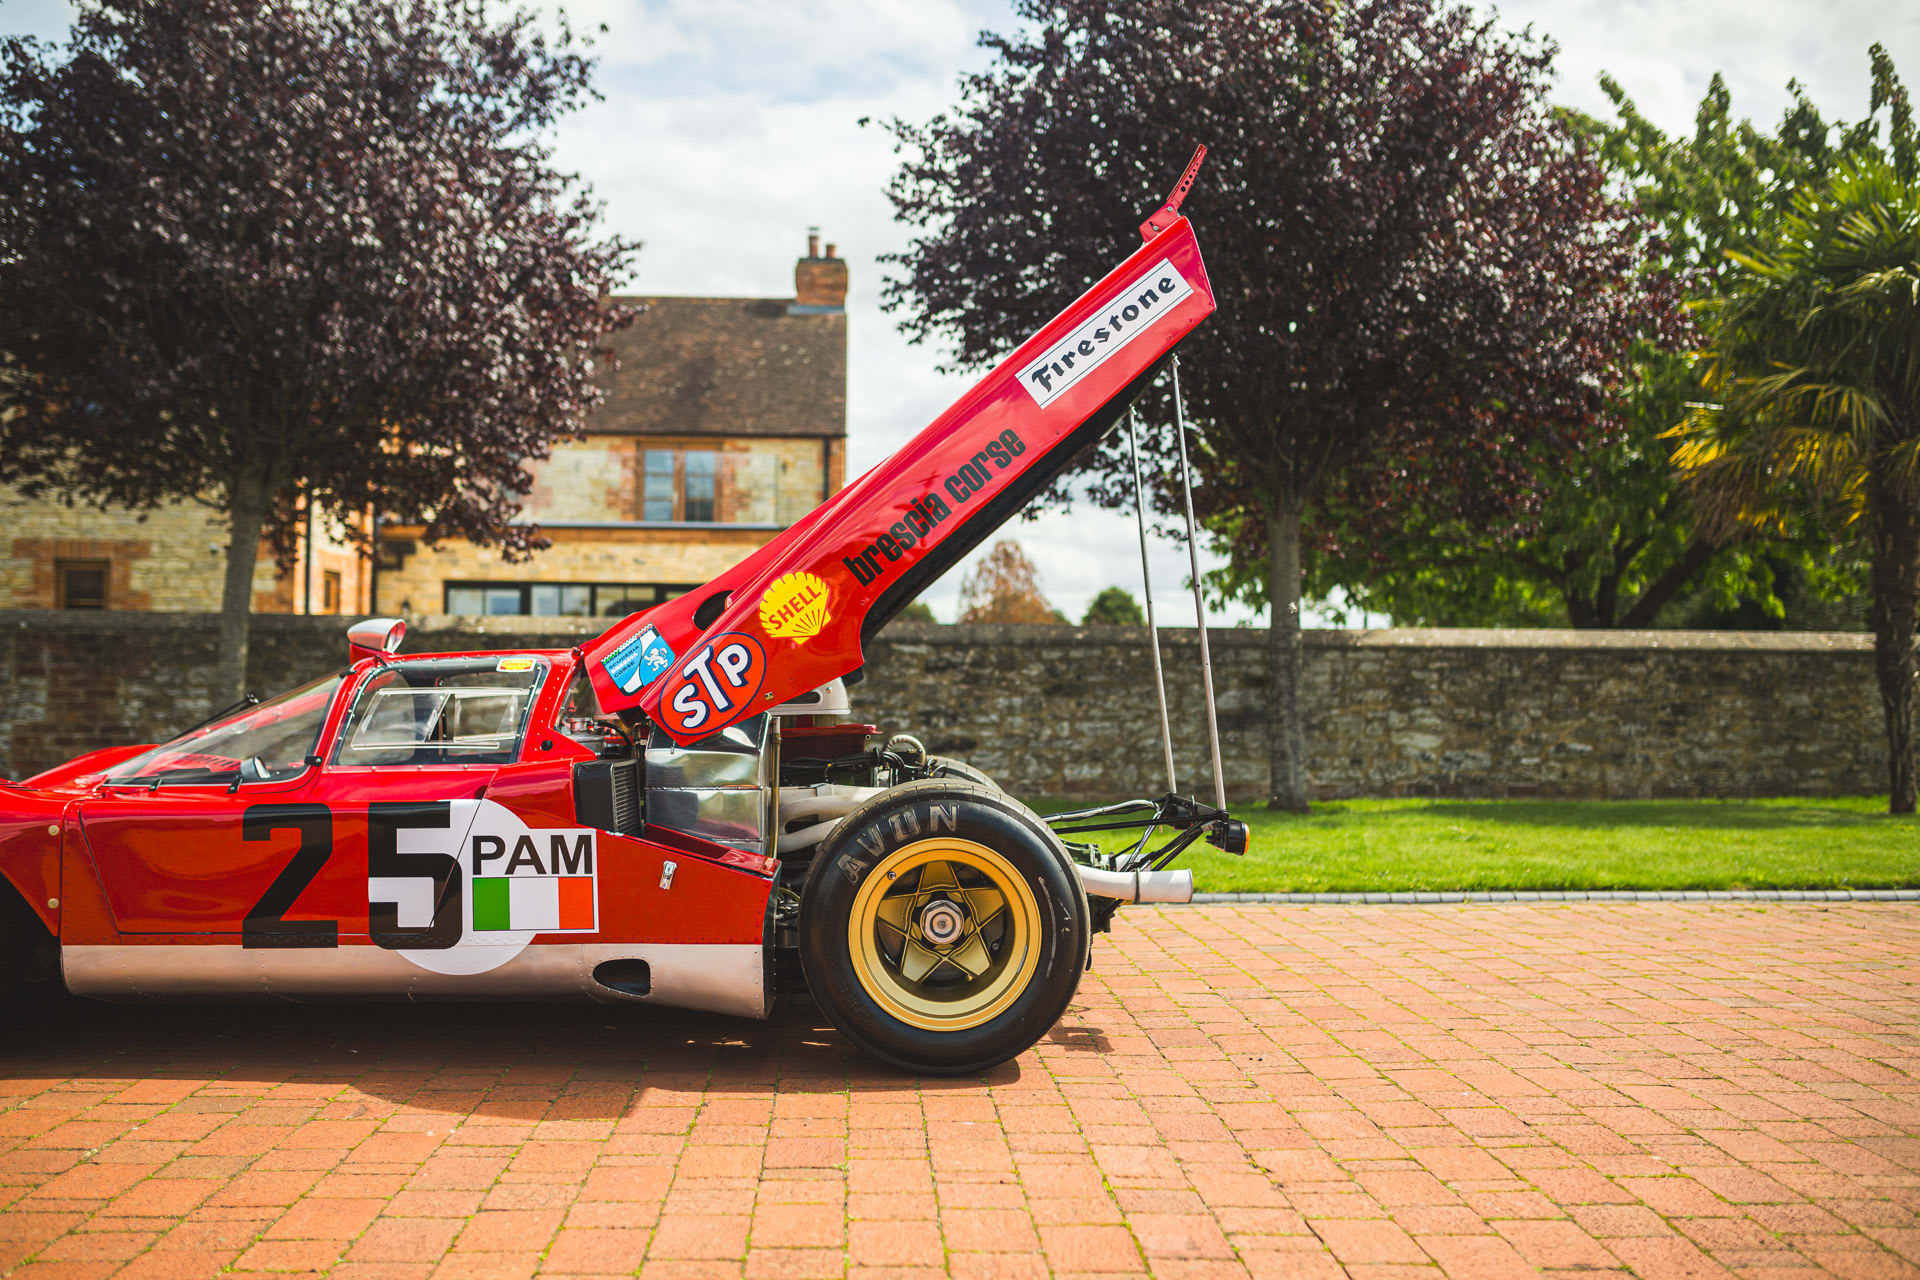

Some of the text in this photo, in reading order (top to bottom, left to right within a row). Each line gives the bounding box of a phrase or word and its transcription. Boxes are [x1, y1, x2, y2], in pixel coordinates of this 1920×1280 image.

[1031, 275, 1177, 394] Firestone
[843, 428, 1027, 588] brescia corse
[768, 584, 822, 631] SHELL
[609, 645, 640, 670] SCUDERIA
[673, 643, 752, 730] STP
[242, 801, 463, 950] 25
[472, 834, 593, 875] PAM
[837, 803, 961, 885] AVON
